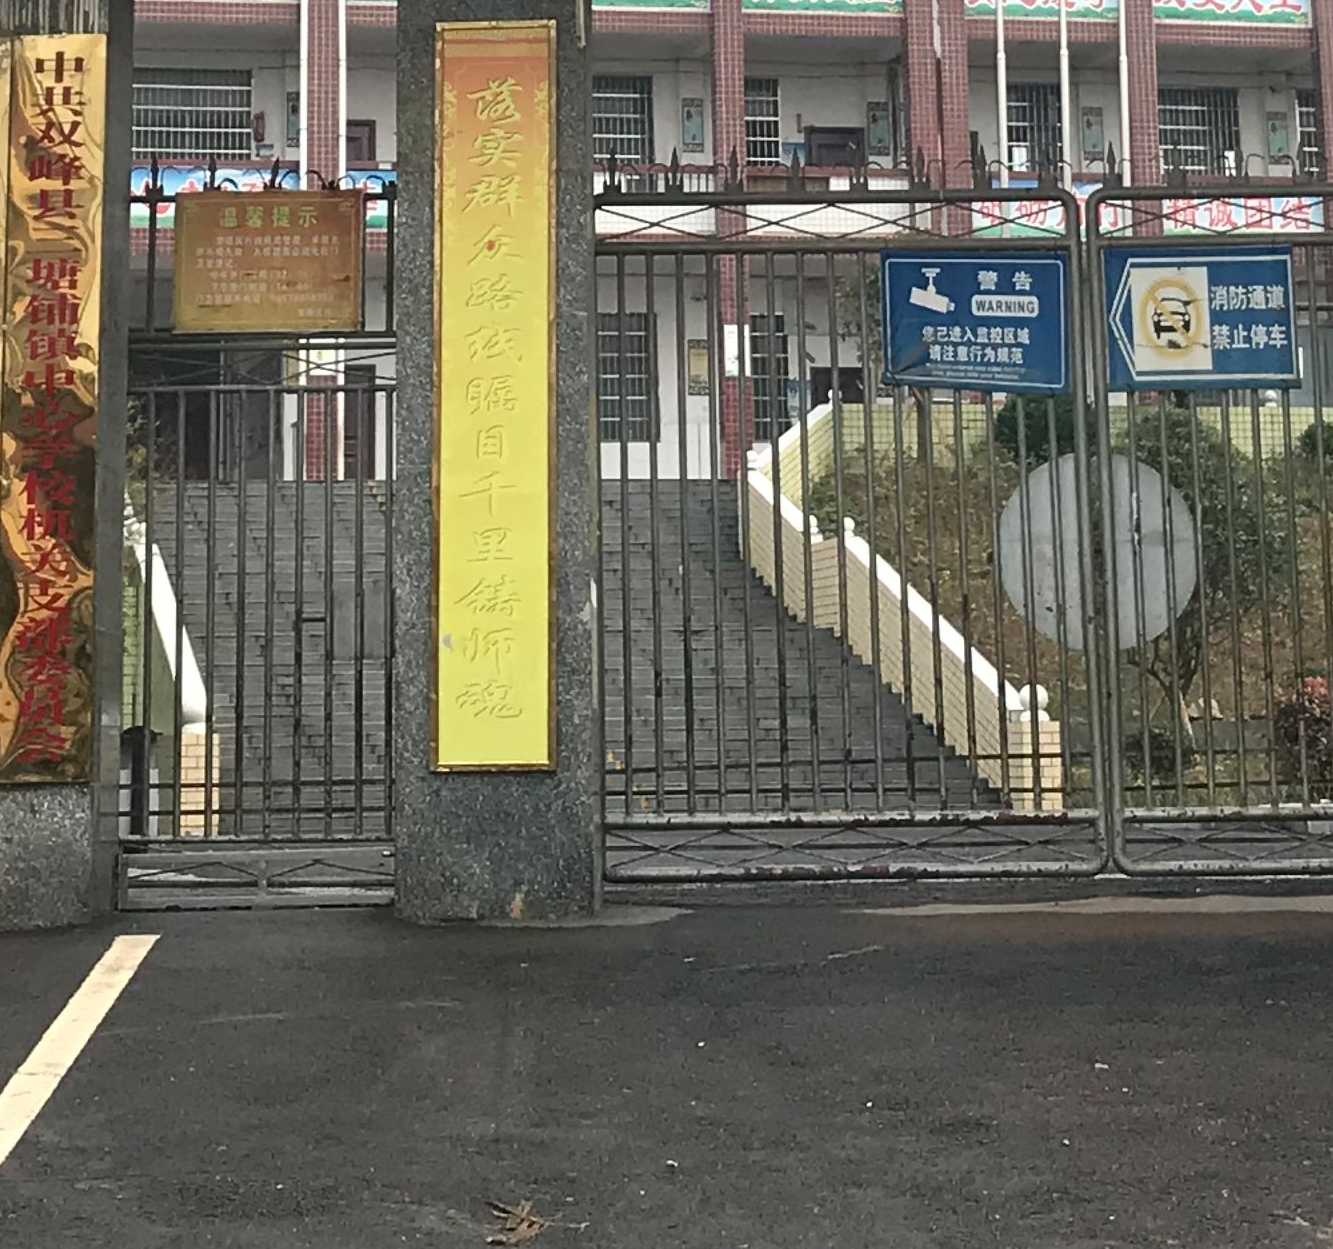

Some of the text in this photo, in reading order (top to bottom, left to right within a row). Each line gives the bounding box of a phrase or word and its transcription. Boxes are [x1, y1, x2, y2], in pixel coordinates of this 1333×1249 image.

[219, 205, 319, 229] 温馨提示
[977, 270, 1033, 291] 警告
[975, 299, 1036, 314] WARNING
[1210, 284, 1286, 311] 消防通道
[1212, 323, 1289, 350] 禁止停车
